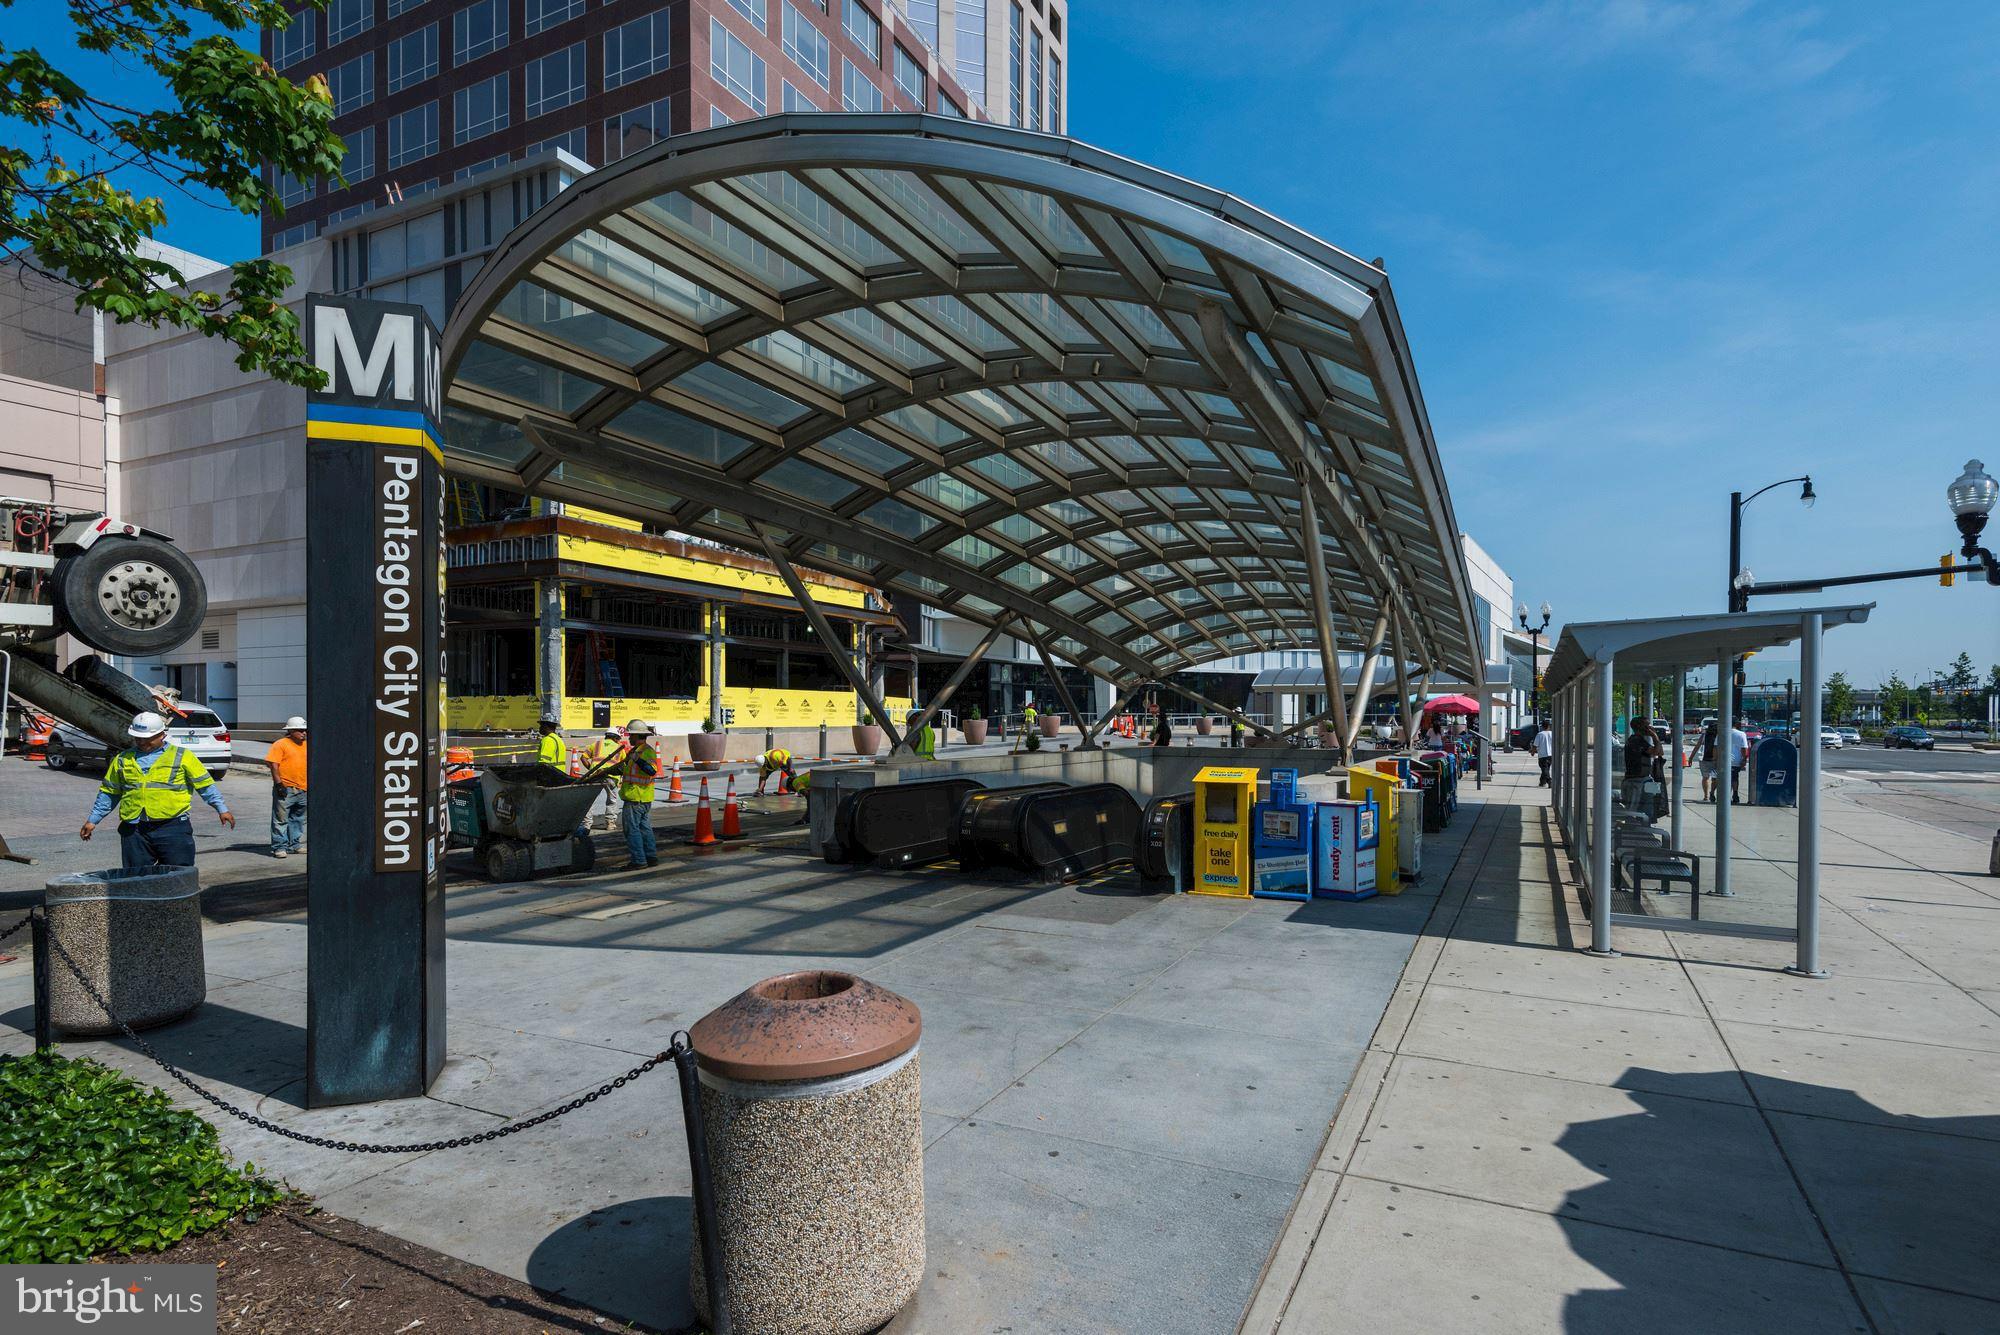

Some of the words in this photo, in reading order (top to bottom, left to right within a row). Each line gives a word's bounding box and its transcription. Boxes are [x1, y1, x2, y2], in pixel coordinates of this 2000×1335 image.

[314, 305, 415, 401] M
[424, 323, 442, 424] M
[376, 456, 418, 633] Pentagon
[438, 474, 447, 639] Pentagon
[376, 645, 419, 719] City
[439, 650, 448, 721] City
[383, 731, 419, 865] Station
[439, 730, 448, 854] Station
[1204, 829, 1220, 838] free
[1220, 829, 1239, 839] daily
[1204, 873, 1238, 884] express
[1210, 848, 1232, 858] take
[1211, 858, 1231, 866] one
